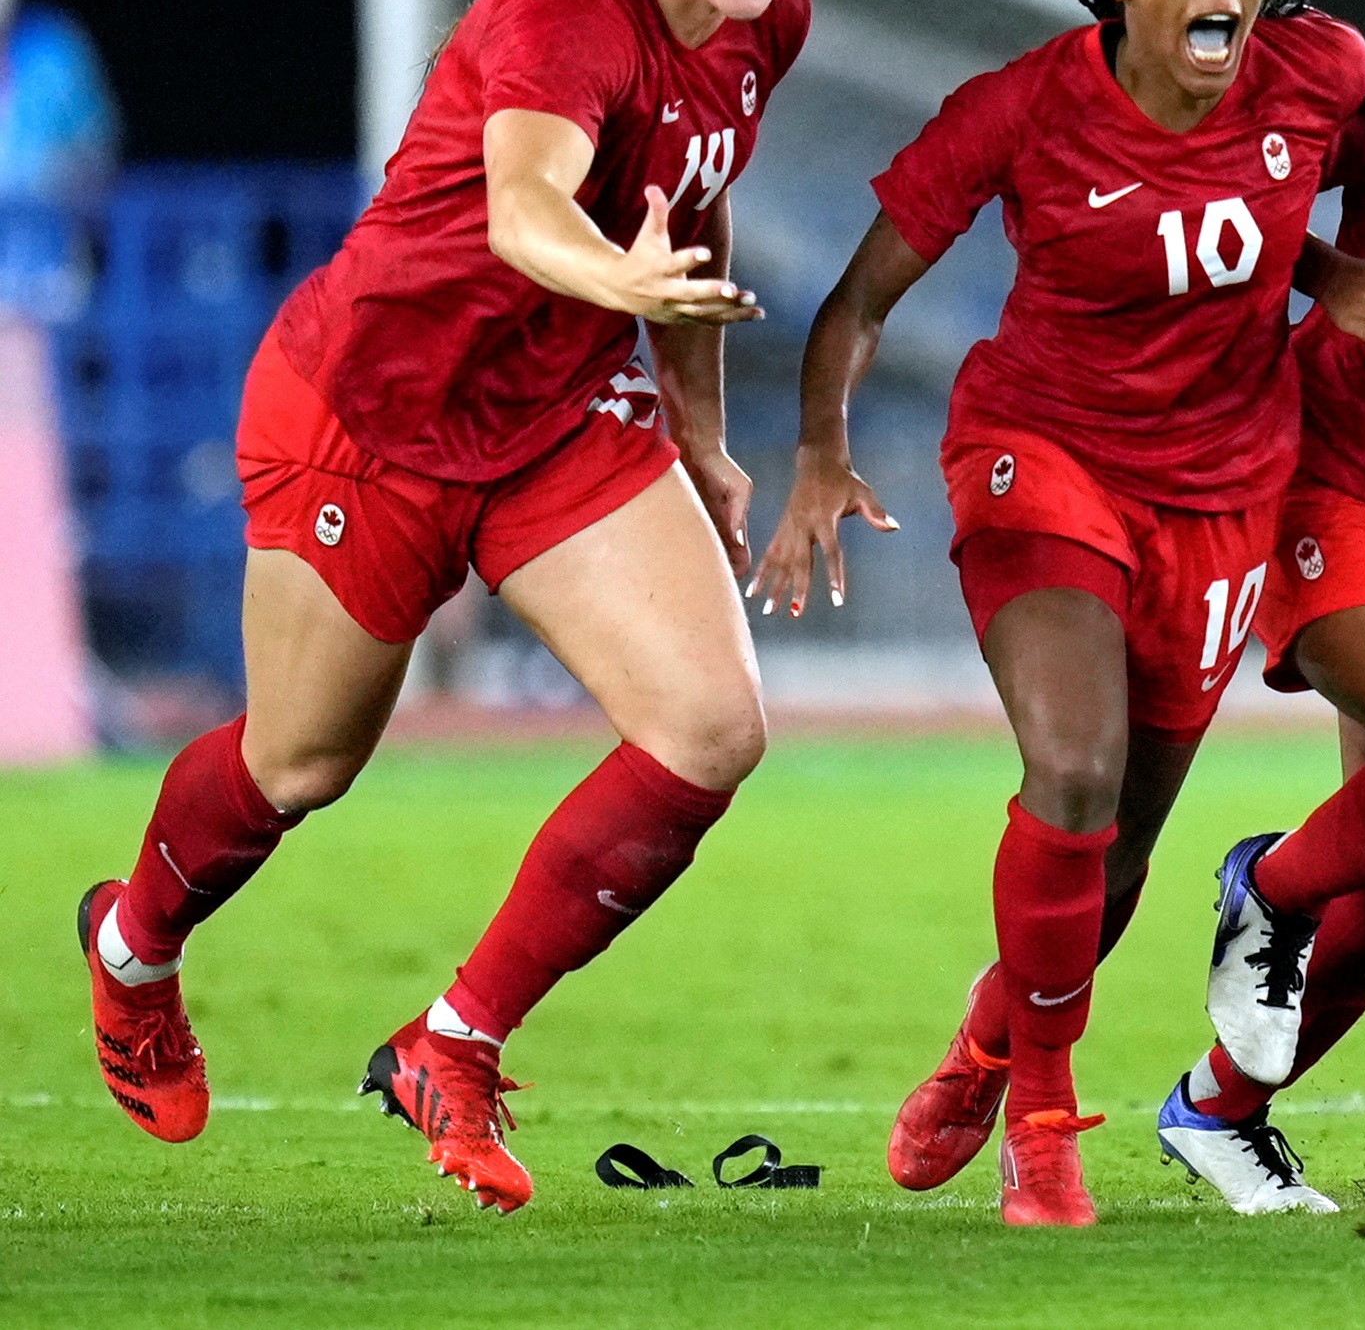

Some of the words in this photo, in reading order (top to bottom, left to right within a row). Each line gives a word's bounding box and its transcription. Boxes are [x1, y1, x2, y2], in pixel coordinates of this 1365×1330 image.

[668, 128, 735, 210] 14
[1157, 197, 1263, 296] 10
[1200, 562, 1266, 670] 10
